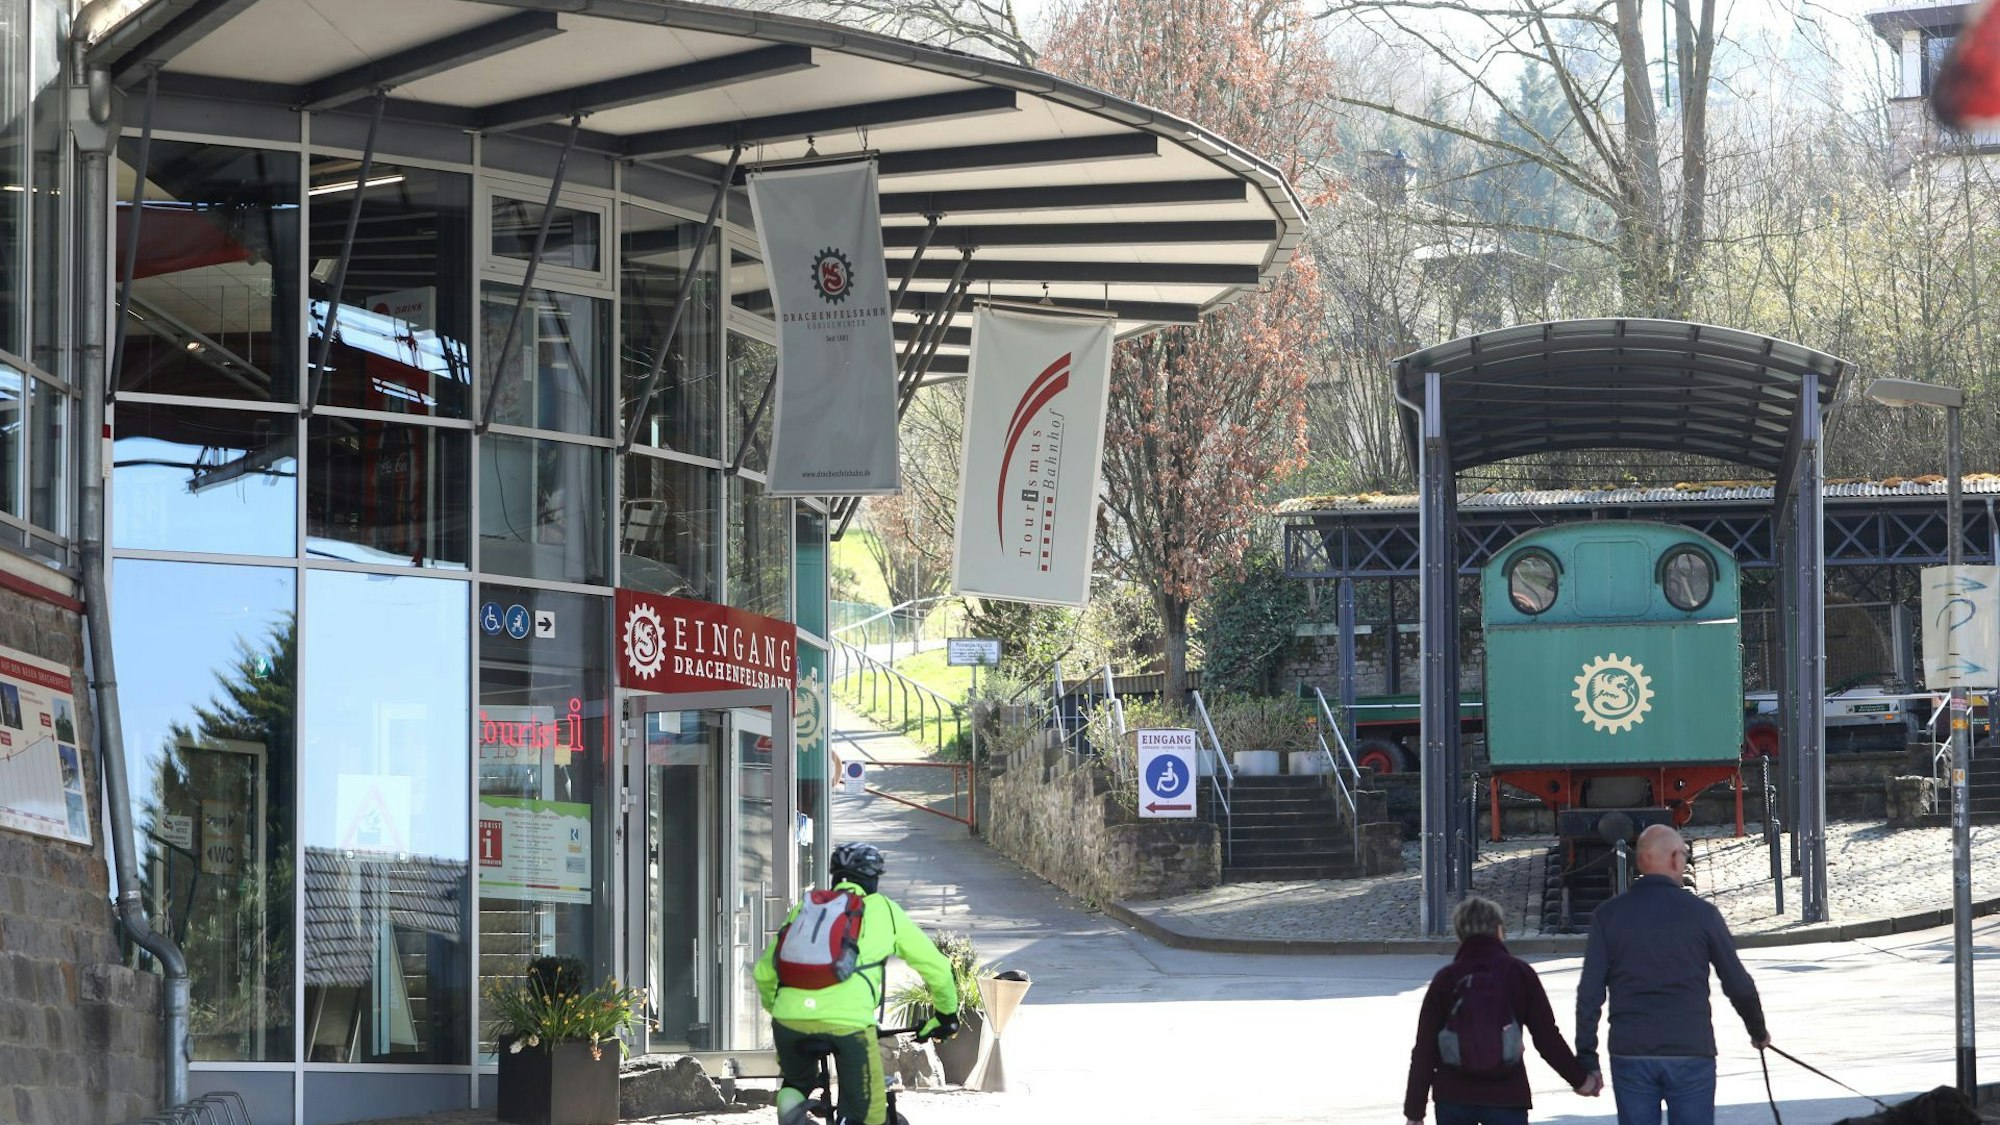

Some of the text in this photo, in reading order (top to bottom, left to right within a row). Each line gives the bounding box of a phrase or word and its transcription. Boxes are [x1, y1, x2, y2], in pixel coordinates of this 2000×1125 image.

[395, 303, 423, 314] DRINK
[783, 307, 886, 322] DRACHENFELSBAHN
[1043, 408, 1065, 490] Bahnhof
[1019, 430, 1042, 557] Tourismus
[673, 616, 792, 672] EINGANG
[674, 655, 792, 690] DRACHENFELSBAHN
[1141, 734, 1191, 745] EINGANG
[1956, 789, 1962, 799] 5
[479, 821, 502, 829] OURIST
[214, 846, 234, 864] WC
